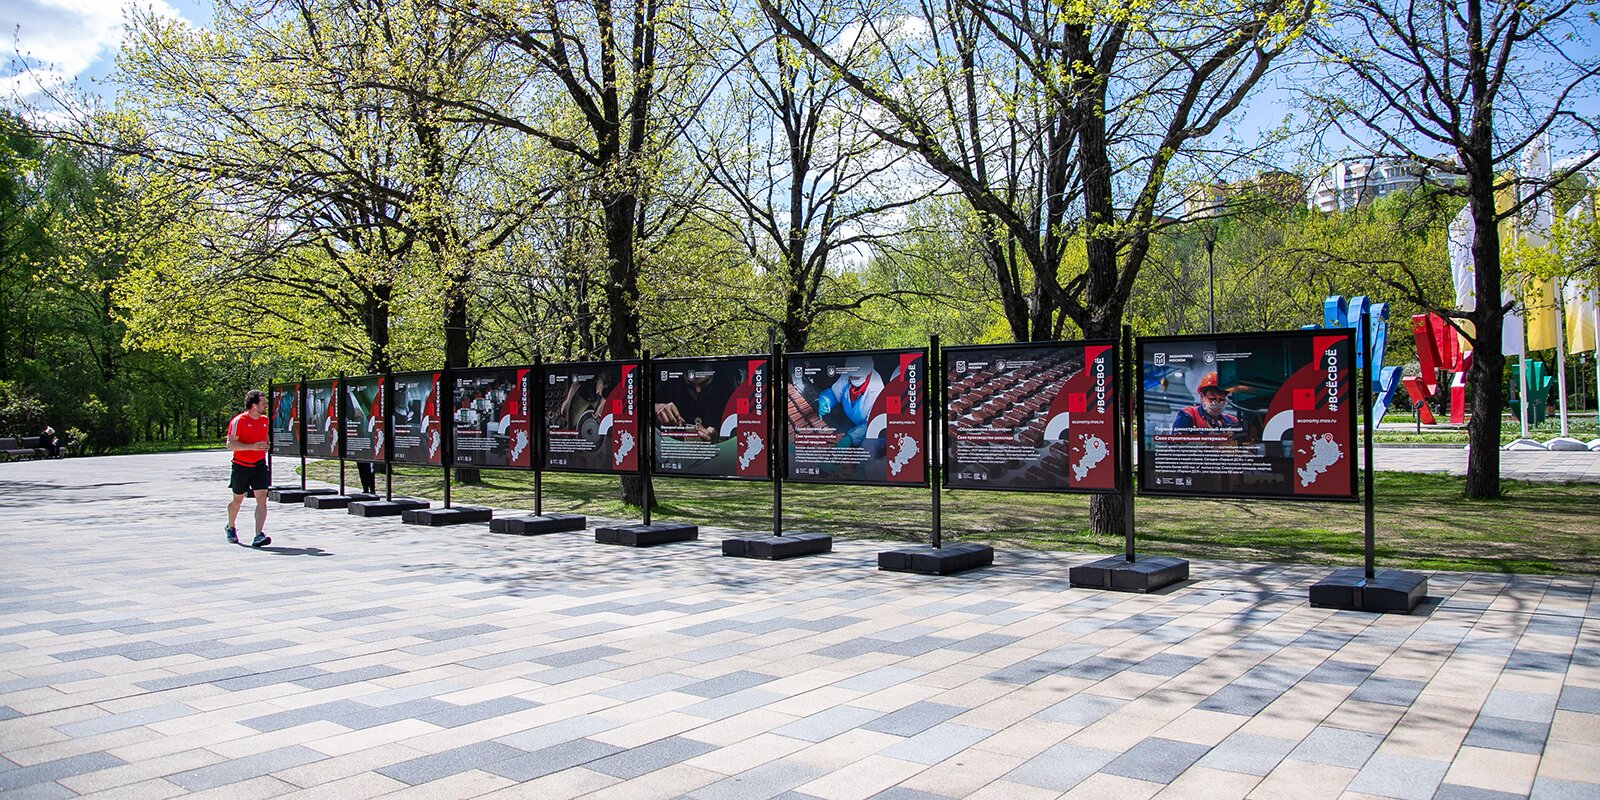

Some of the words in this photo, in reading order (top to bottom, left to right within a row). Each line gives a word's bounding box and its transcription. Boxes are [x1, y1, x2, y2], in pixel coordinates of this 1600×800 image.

[755, 369, 763, 416] #ВСЁСВОЁ
[907, 364, 917, 416] #ВСЁСВОЁ
[1095, 357, 1105, 414] #ВСЁСВОЁ
[1325, 349, 1338, 412] #ВСЁСВОЁ
